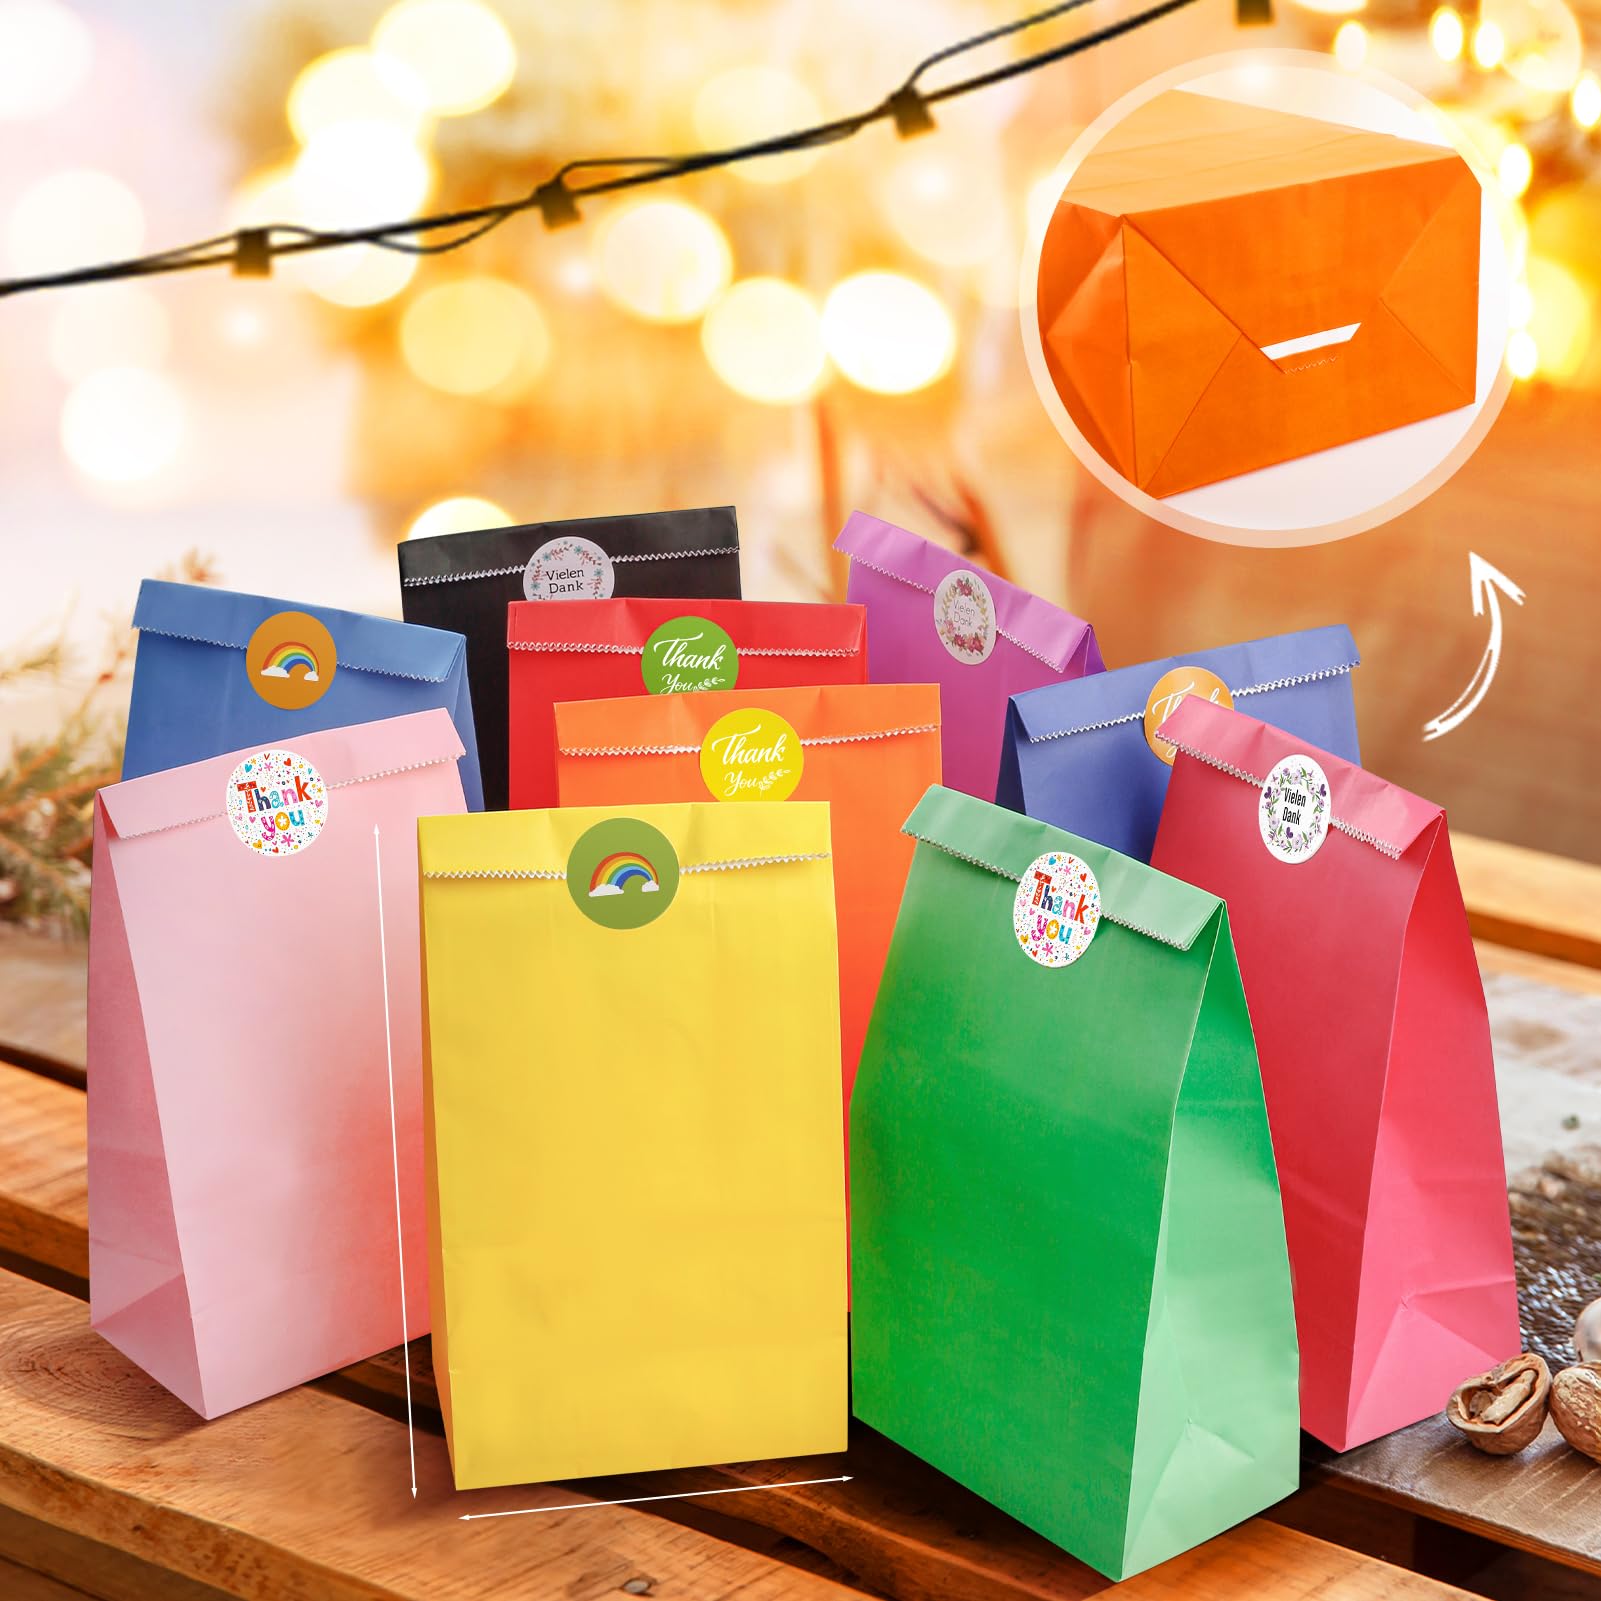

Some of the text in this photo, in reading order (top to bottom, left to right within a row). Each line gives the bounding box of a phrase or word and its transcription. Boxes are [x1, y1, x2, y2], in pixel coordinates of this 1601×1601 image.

[546, 568, 584, 581] Vielen
[549, 580, 584, 594] Dank
[953, 599, 976, 617] Vielen
[653, 632, 727, 670] Thank
[660, 673, 693, 695] You
[711, 723, 787, 766] Thank
[237, 775, 313, 813] Thank
[724, 770, 757, 797] You
[1284, 786, 1307, 808] Vielen
[261, 809, 305, 841] you
[1282, 806, 1302, 826] Dank
[1032, 870, 1089, 924] Thank
[1031, 915, 1072, 944] you
